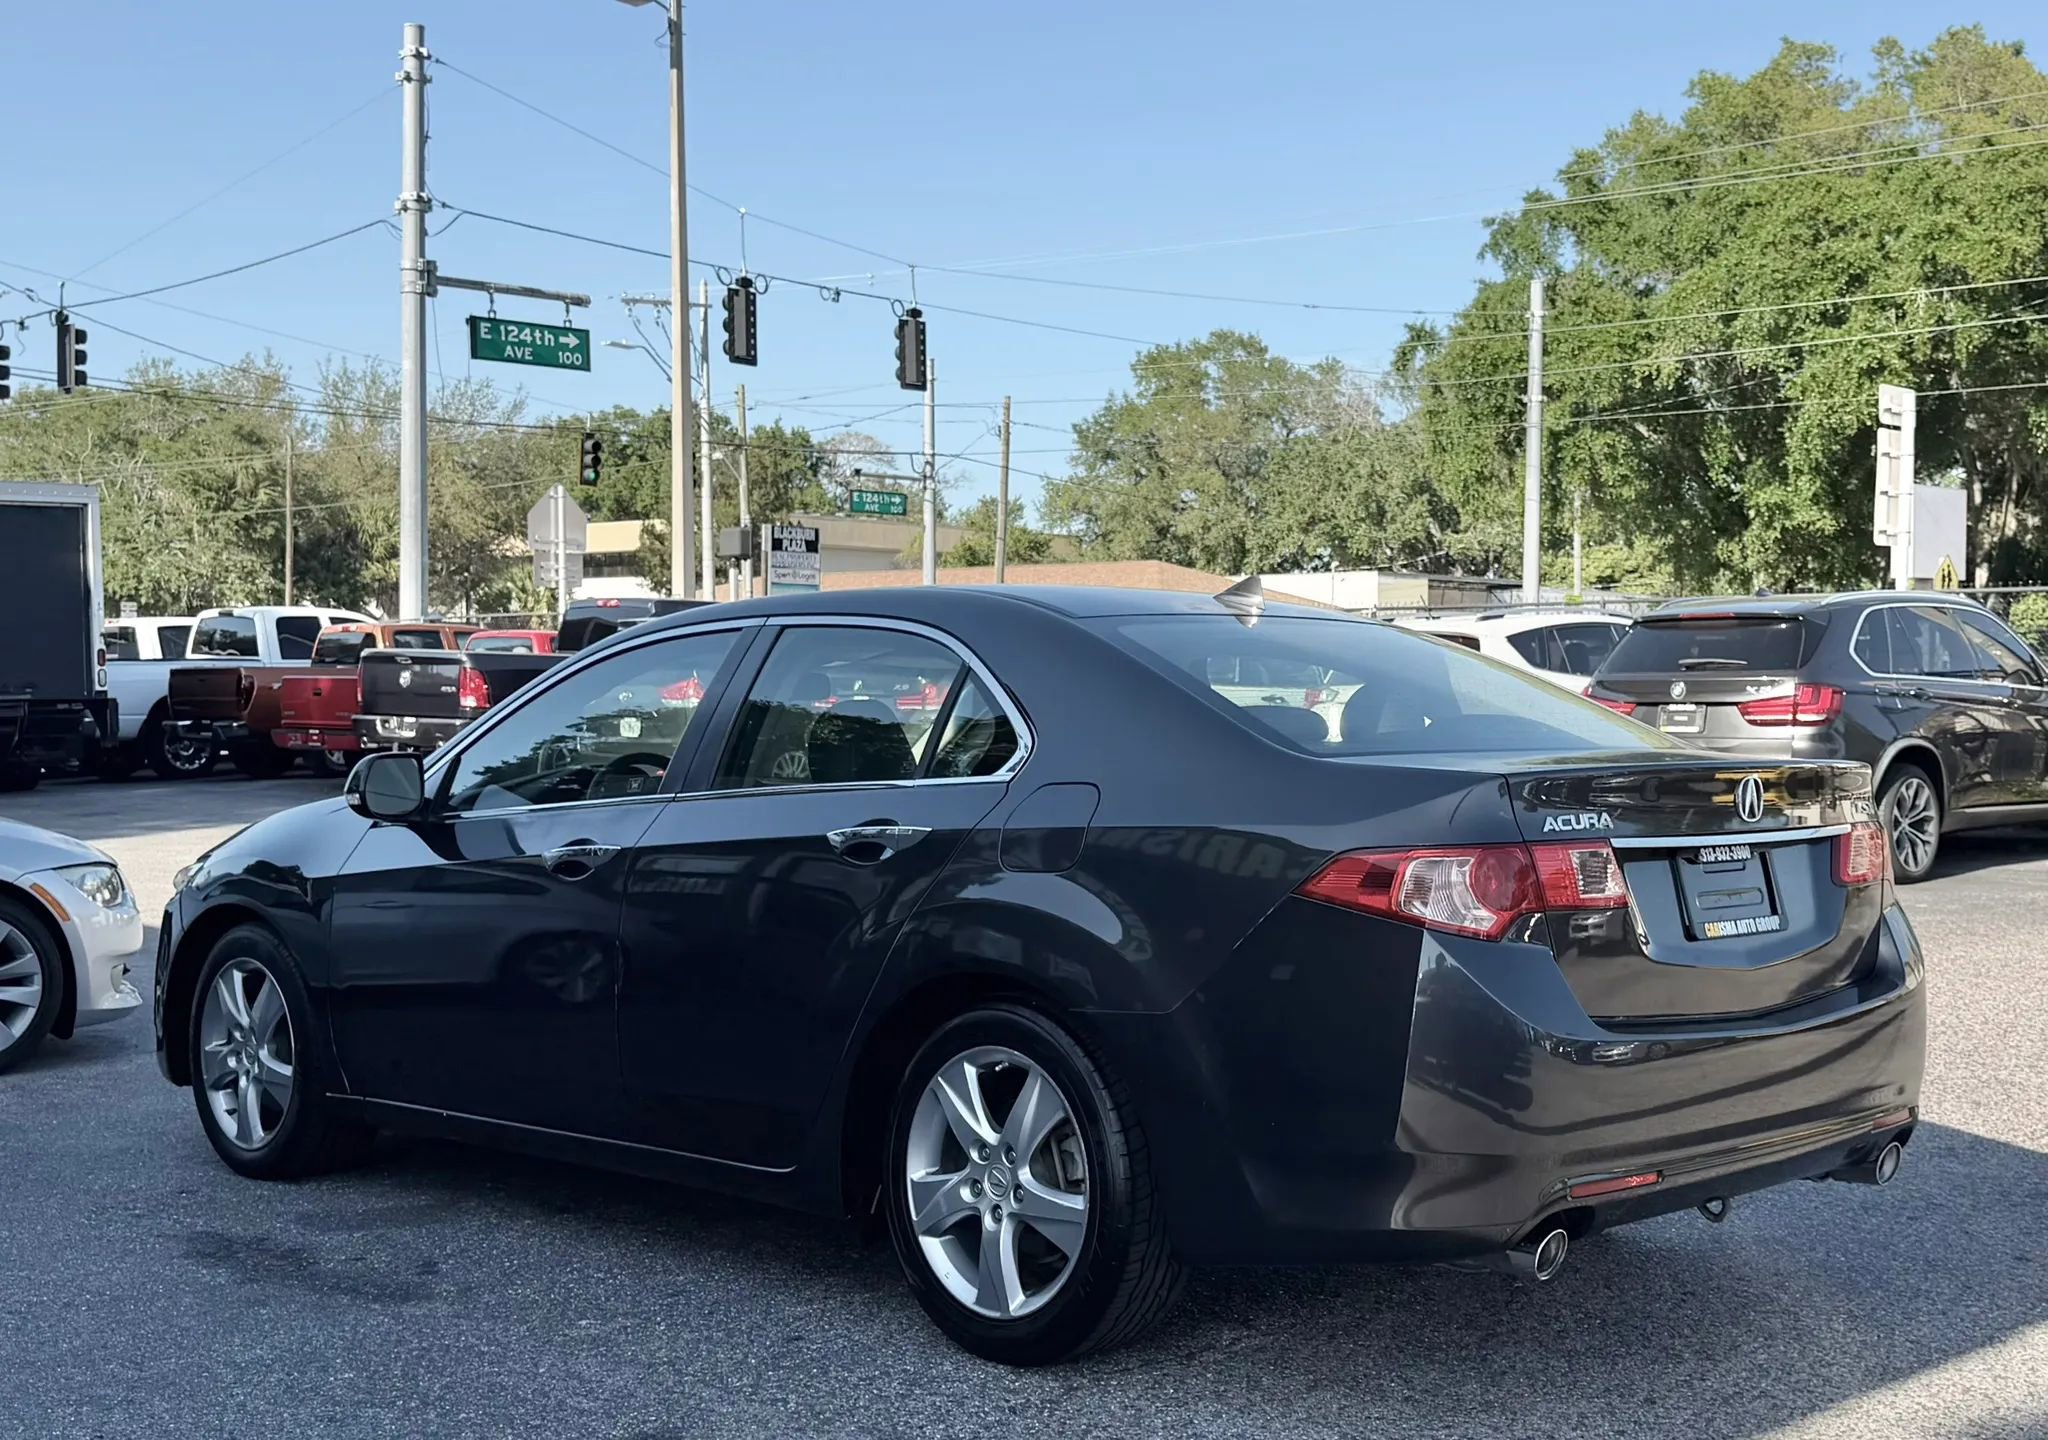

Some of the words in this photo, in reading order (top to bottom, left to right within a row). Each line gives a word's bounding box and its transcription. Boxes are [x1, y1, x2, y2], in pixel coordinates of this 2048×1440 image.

[480, 322, 492, 339] E
[499, 325, 555, 347] 124th
[504, 345, 533, 360] AVE
[558, 351, 582, 365] 100
[853, 492, 860, 502] E
[863, 493, 890, 504] 124th
[864, 503, 880, 512] AVE
[782, 539, 807, 552] PLAZA
[1542, 812, 1614, 833] ACURA
[1704, 920, 1738, 938] CARISMA
[1736, 918, 1757, 934] AUTO
[1755, 915, 1780, 932] GROUP
